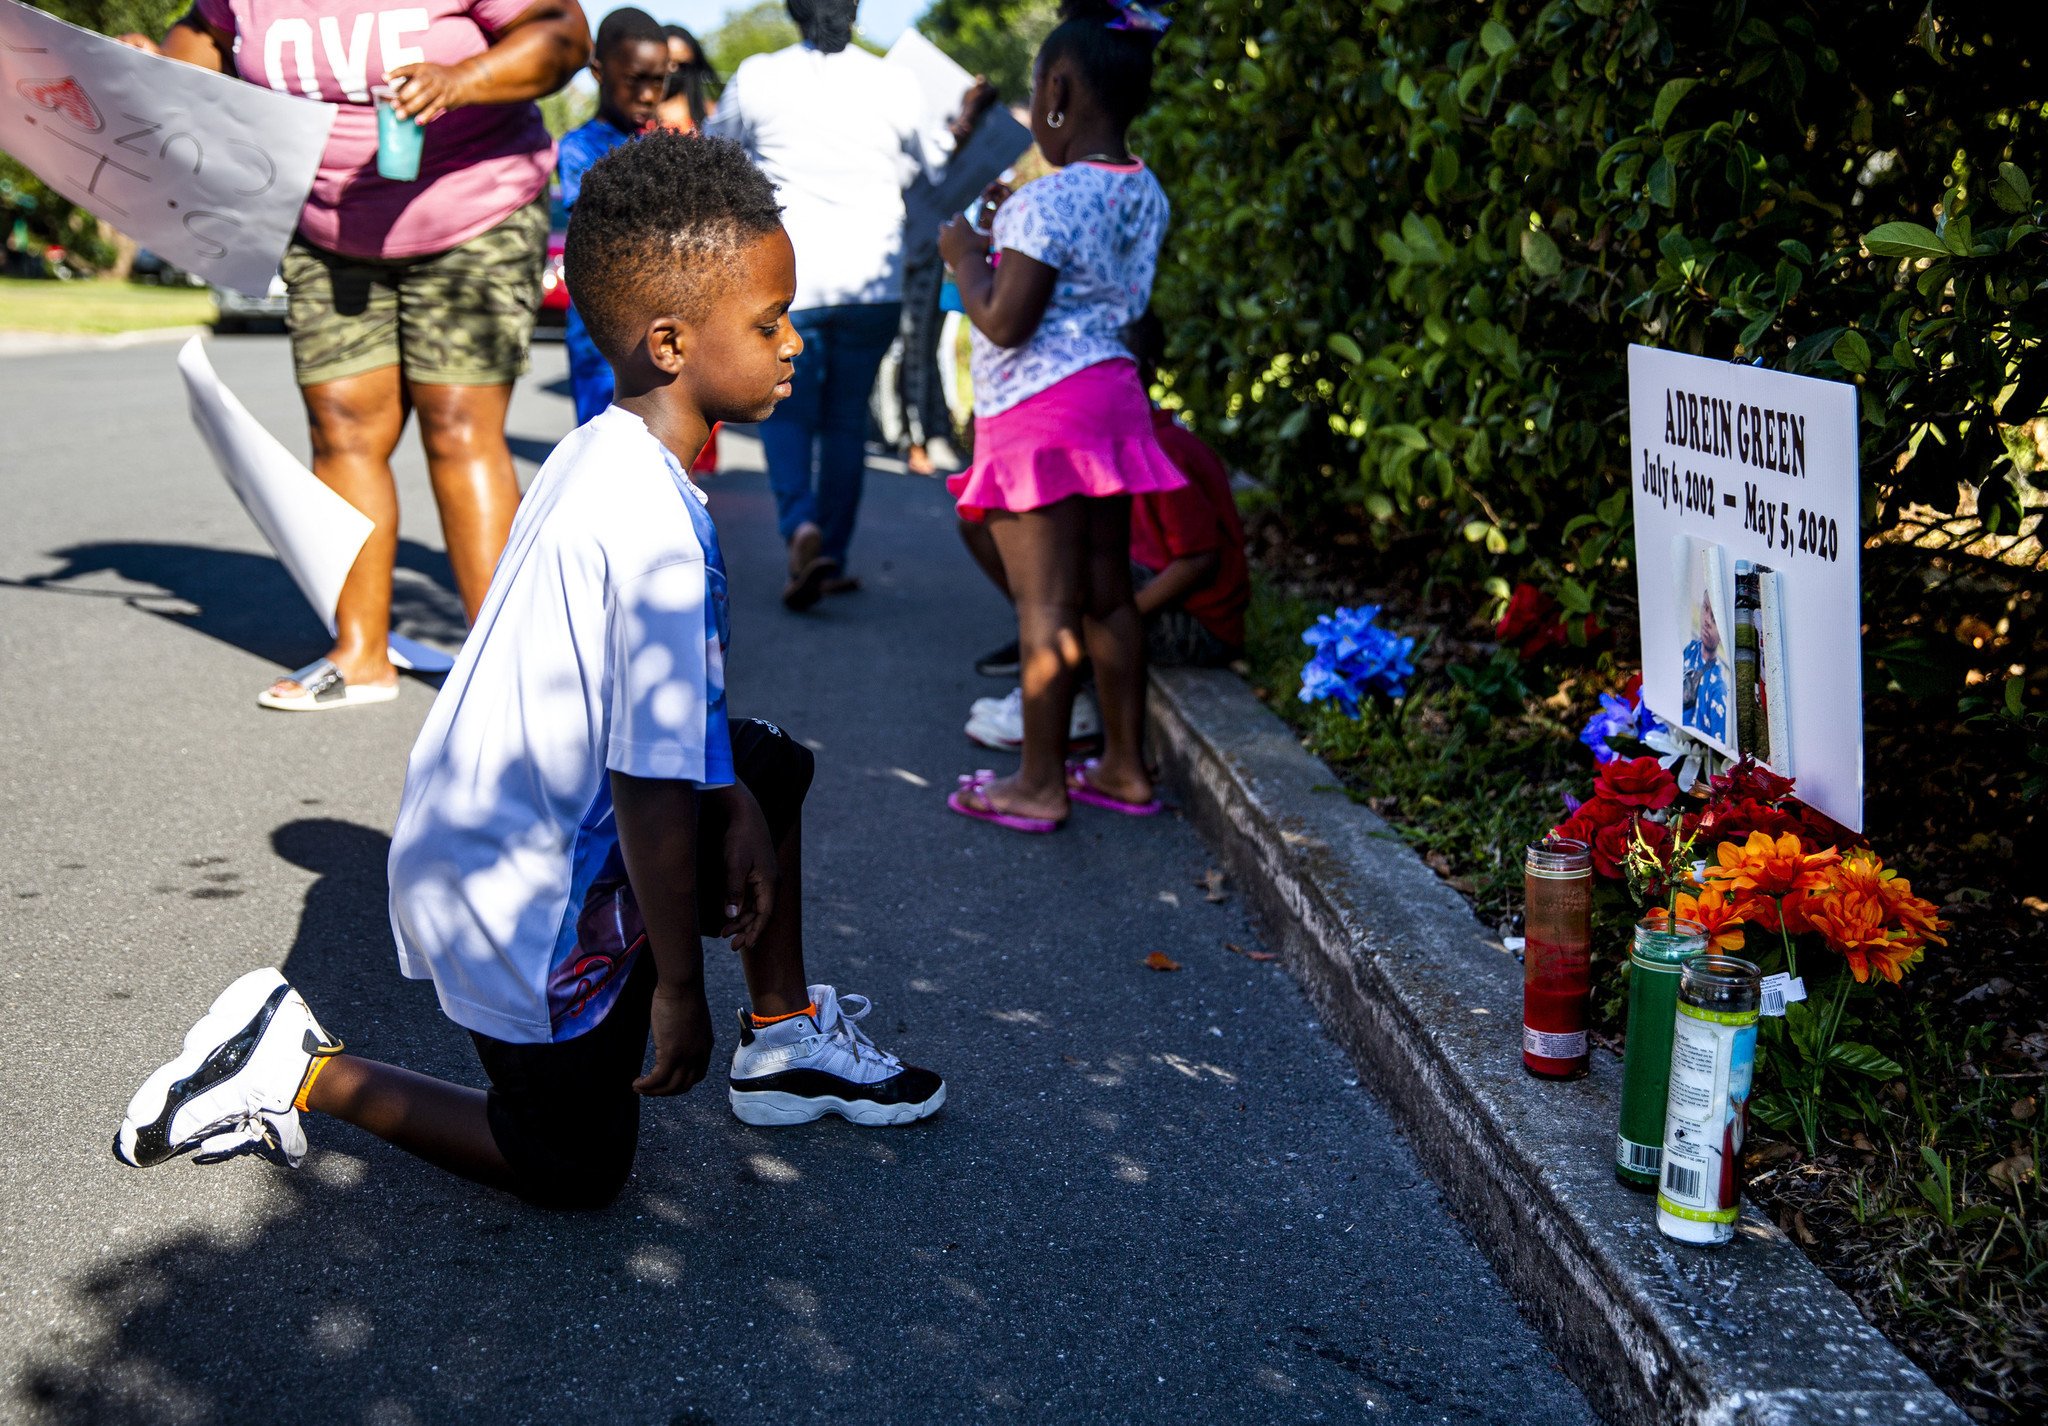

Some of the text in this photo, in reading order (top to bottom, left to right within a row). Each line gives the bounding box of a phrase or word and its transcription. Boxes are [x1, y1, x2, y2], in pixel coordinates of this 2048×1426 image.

[1665, 388, 1805, 479] ADREIN GREEN
[1642, 448, 1669, 510] July
[1671, 460, 1683, 516] 6,
[1685, 470, 1715, 519] 2002
[1744, 481, 1776, 549] May
[1780, 502, 1795, 557] 5,
[1798, 508, 1838, 562] 2020
